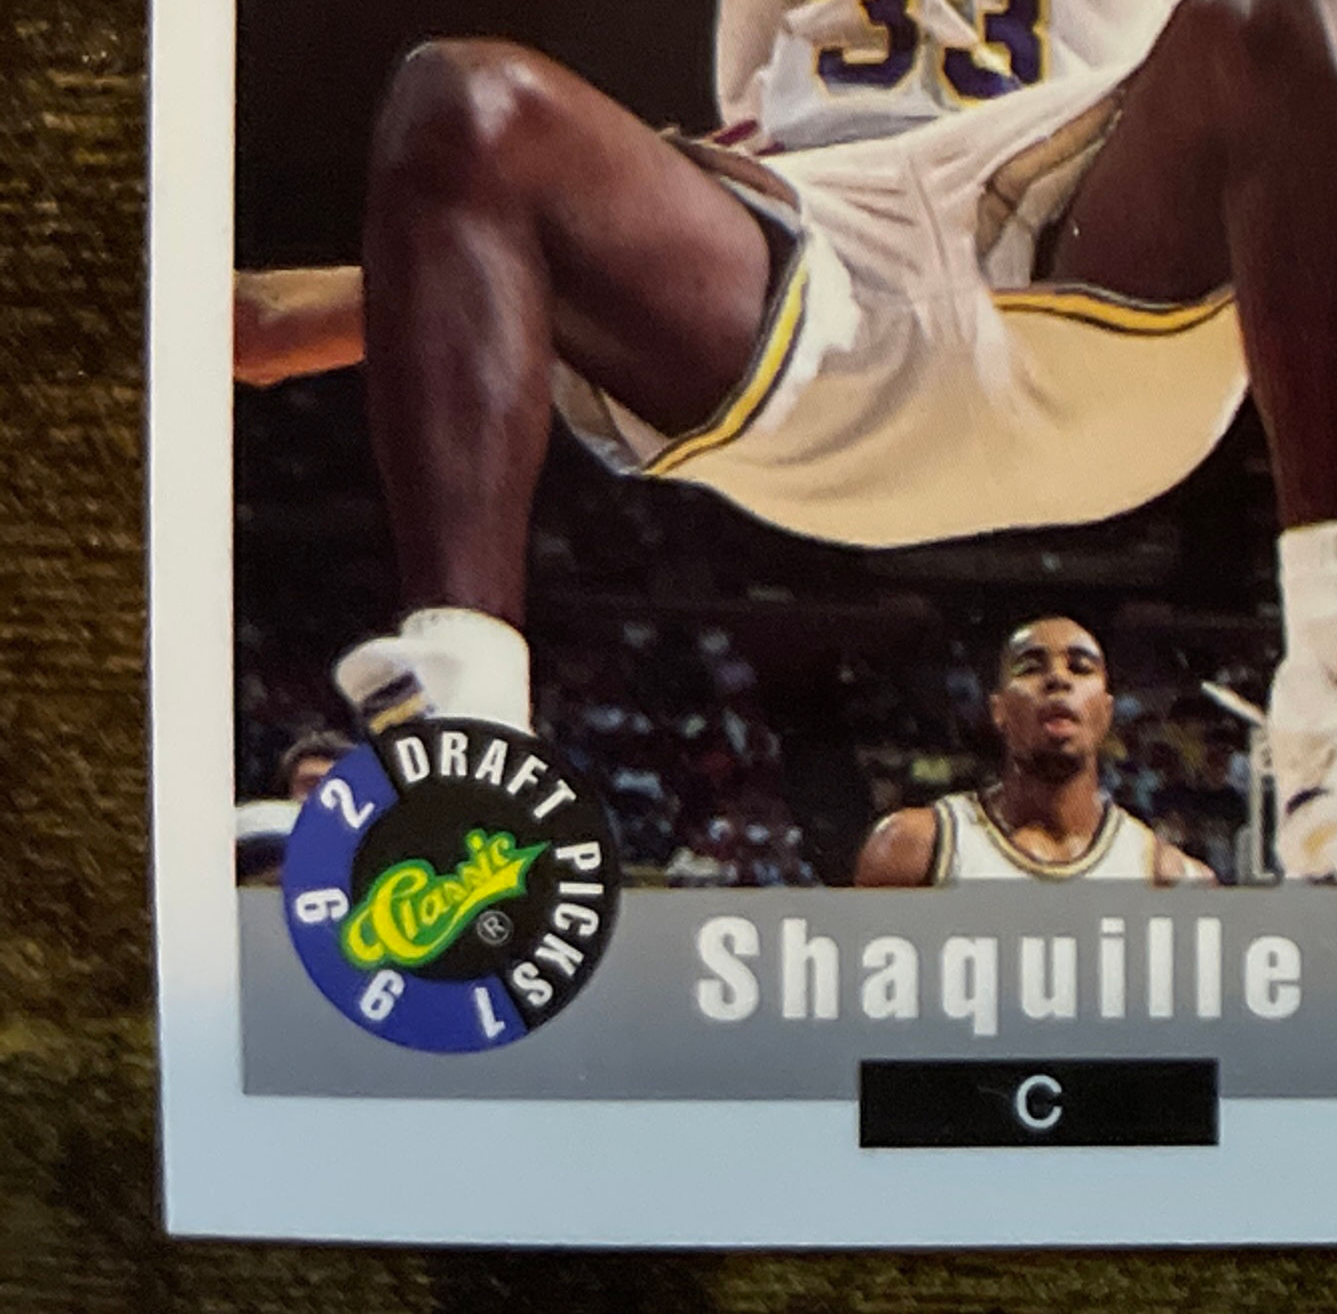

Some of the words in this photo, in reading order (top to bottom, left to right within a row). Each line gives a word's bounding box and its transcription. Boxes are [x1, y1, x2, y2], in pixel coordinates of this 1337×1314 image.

[343, 829, 530, 966] Classic
[396, 730, 577, 821] DRAFT
[511, 840, 604, 1009] PICKS
[694, 914, 1304, 1038] Shaquille
[1014, 1074, 1063, 1129] C
